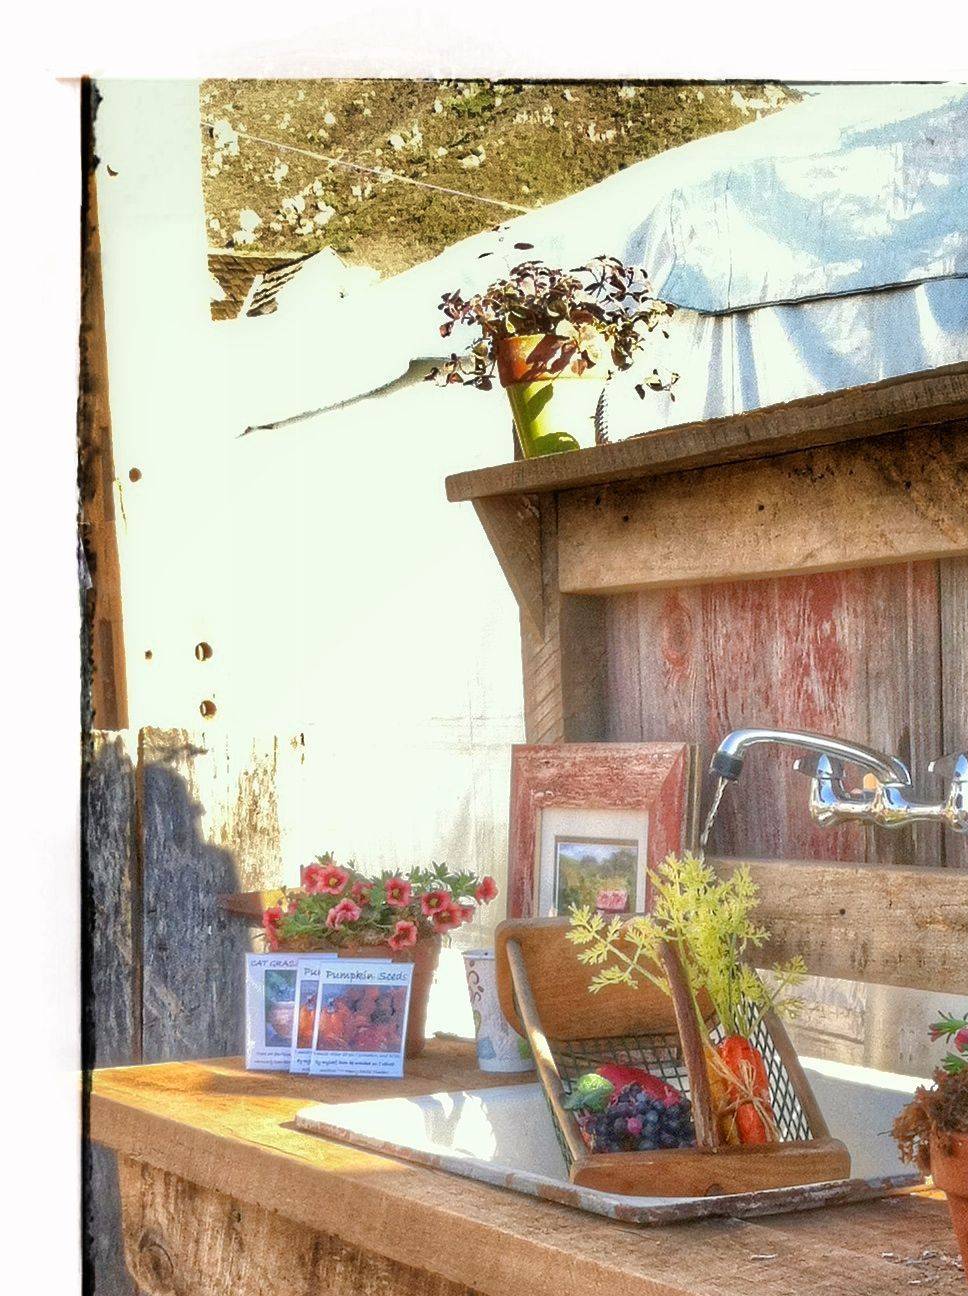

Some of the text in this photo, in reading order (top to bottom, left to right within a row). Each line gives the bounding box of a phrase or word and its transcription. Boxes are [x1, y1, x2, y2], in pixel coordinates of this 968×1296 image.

[250, 959, 267, 967] CAT
[326, 970, 408, 982] Pumpkin Seeds
